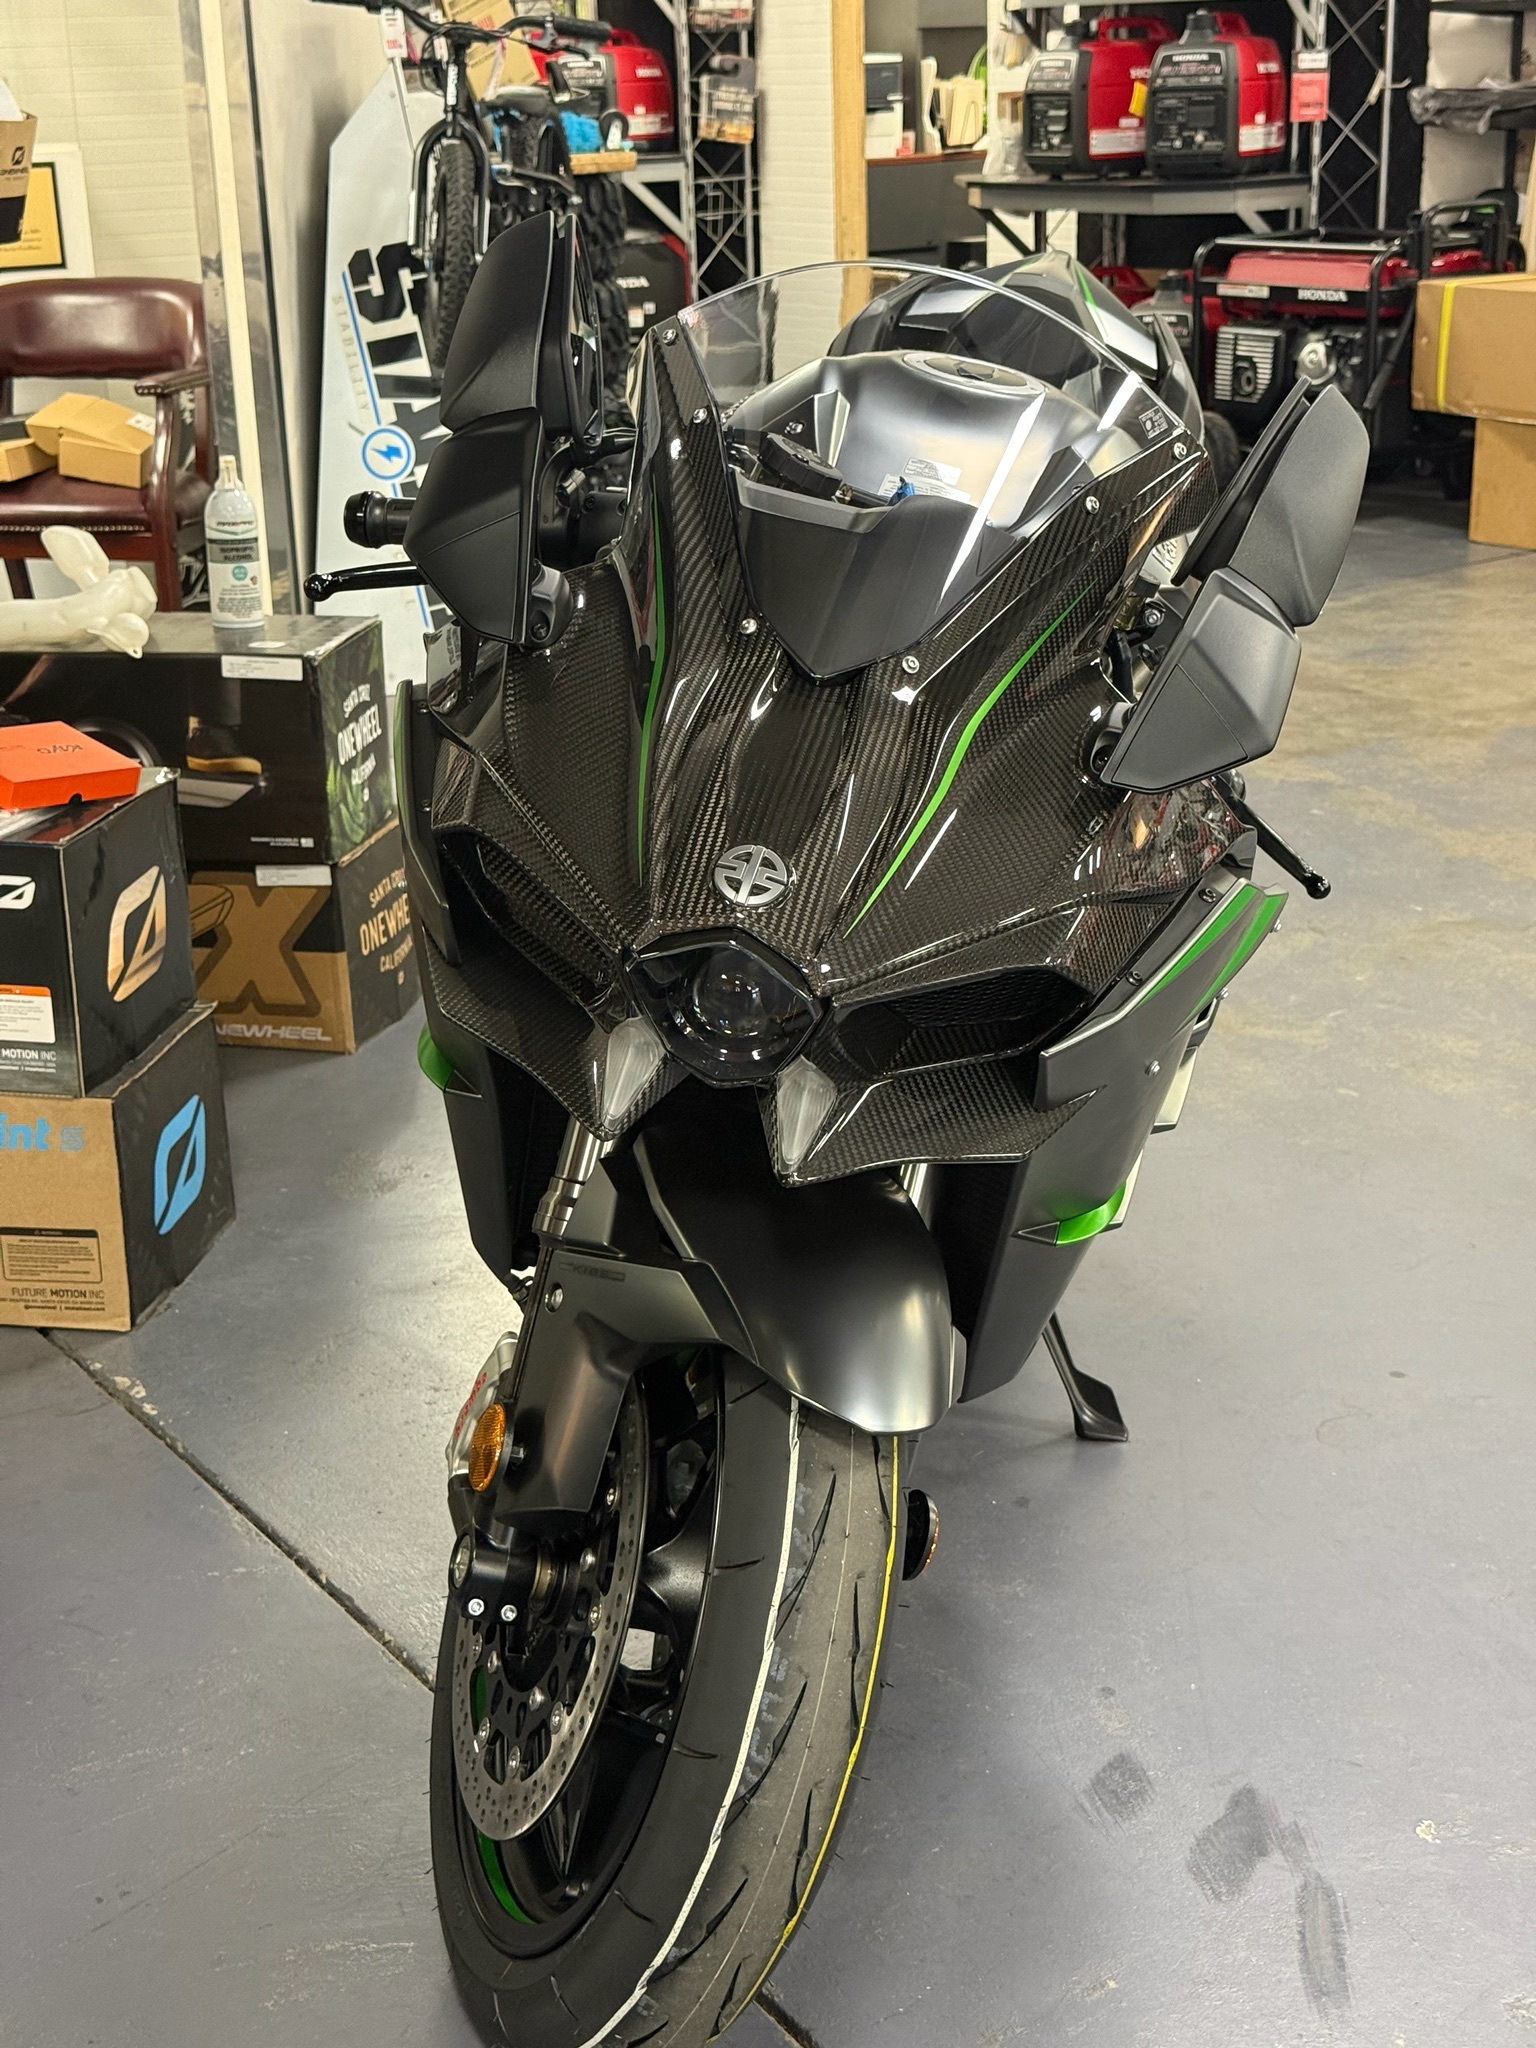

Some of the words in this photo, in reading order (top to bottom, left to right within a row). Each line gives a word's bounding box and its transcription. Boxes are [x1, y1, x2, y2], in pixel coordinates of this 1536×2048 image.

[1297, 288, 1348, 302] HONDA
[337, 703, 382, 765] ONEWHEEL
[369, 876, 392, 909] SANTA
[359, 892, 411, 956] ONEWHE
[215, 1023, 333, 1042] NEWHEEL
[1, 1048, 39, 1060] MOTION
[40, 1051, 57, 1062] INC
[0, 1111, 50, 1151] int
[11, 1287, 47, 1297] FUTURE
[50, 1288, 87, 1299] MOTION
[88, 1290, 105, 1299] INC
